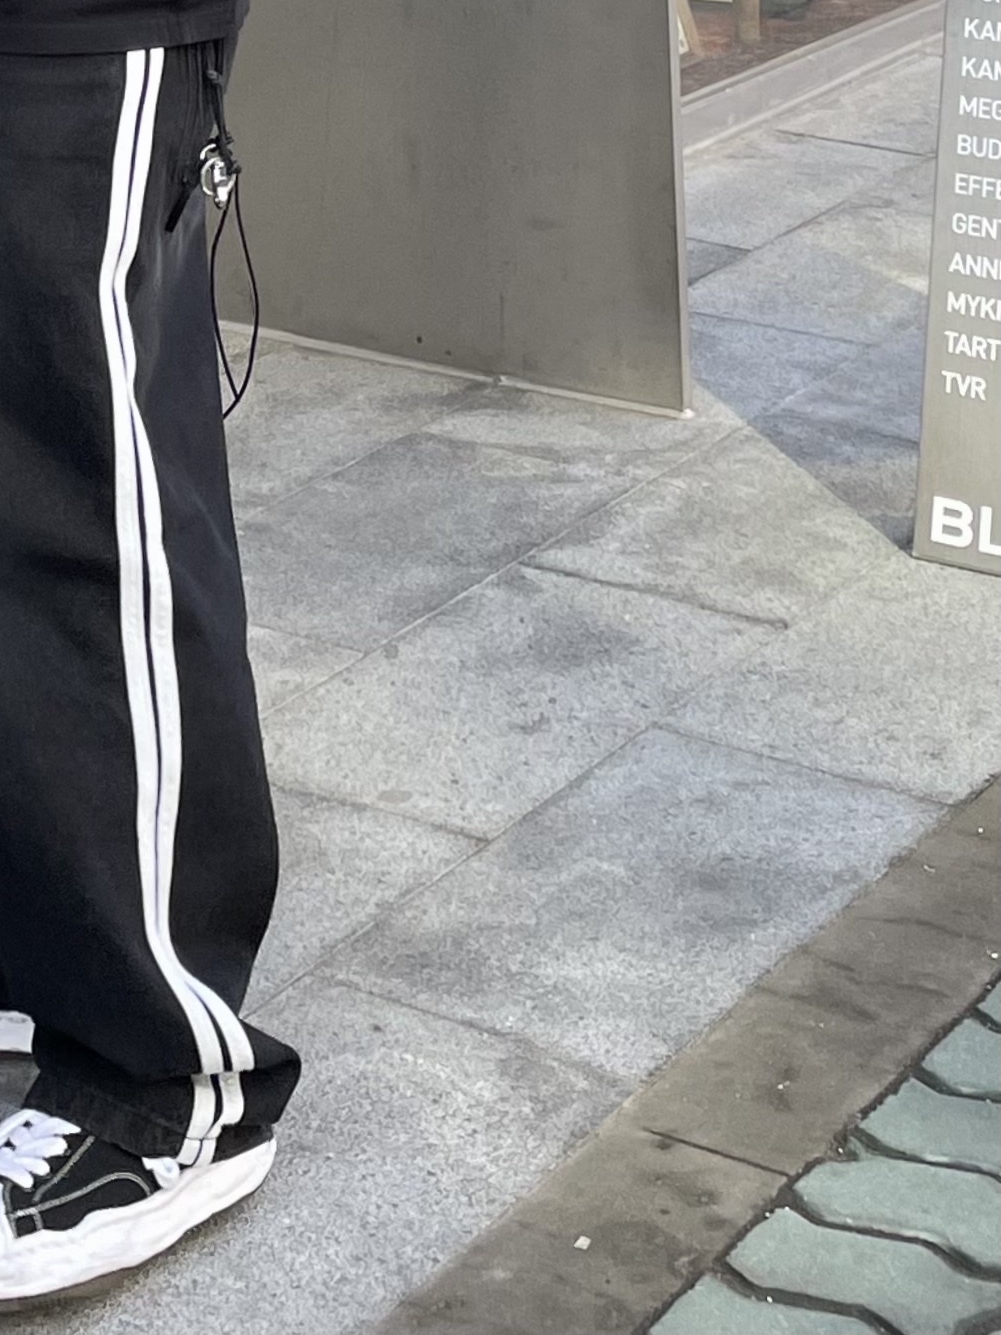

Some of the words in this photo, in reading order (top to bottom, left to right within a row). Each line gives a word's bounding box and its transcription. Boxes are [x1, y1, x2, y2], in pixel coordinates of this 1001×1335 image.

[956, 133, 1001, 160] BUD
[951, 212, 1001, 241] GEN
[948, 251, 1001, 281] ANN
[943, 330, 1001, 362] TART
[941, 369, 988, 401] TVR
[930, 494, 1001, 557] BL
